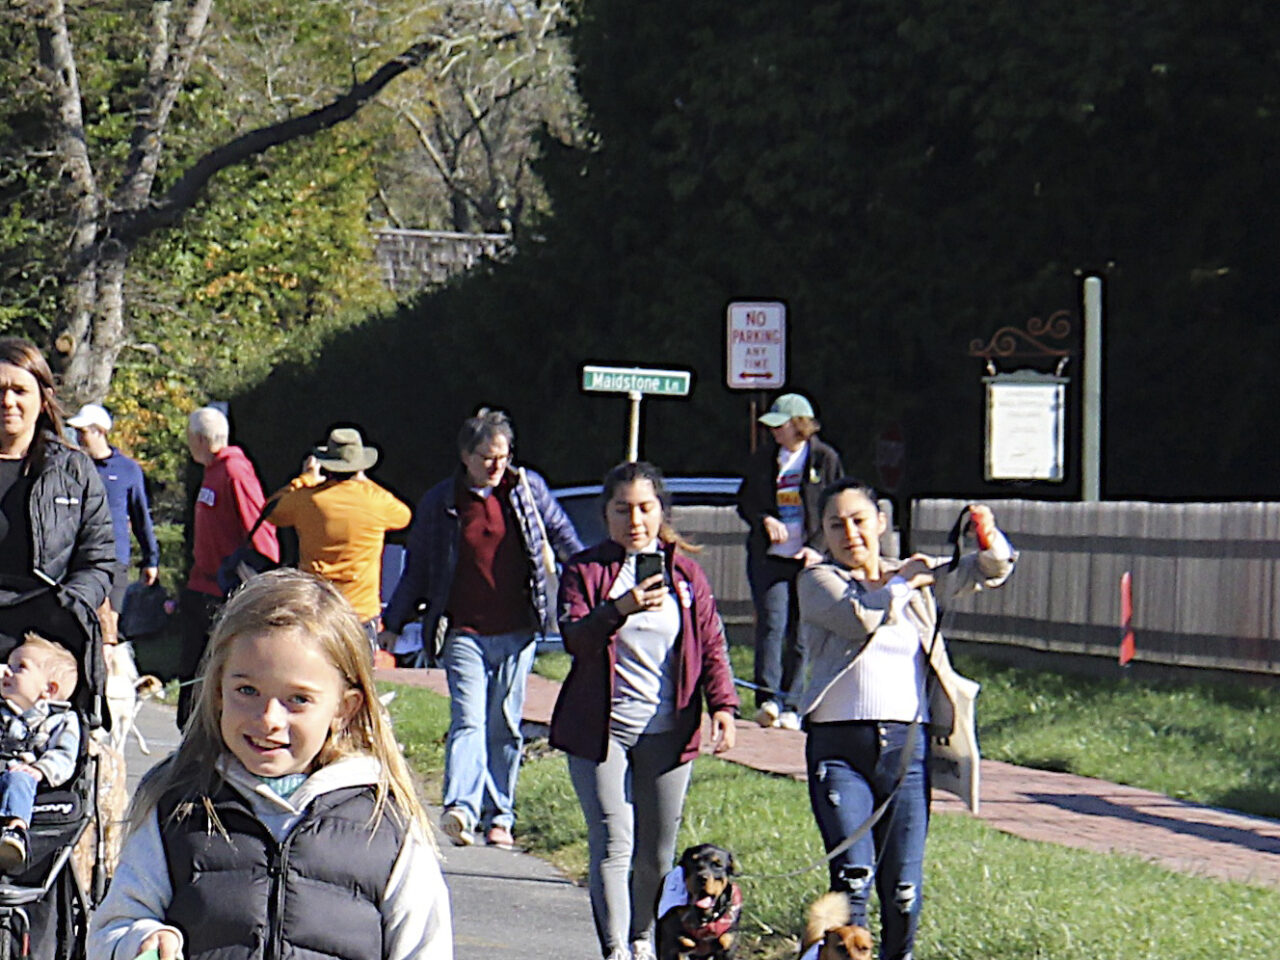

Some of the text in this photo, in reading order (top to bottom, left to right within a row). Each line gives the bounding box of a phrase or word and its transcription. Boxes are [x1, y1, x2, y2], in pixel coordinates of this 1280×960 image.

[746, 311, 767, 327] NO
[733, 329, 781, 344] PARKING
[746, 347, 767, 356] ANY
[745, 359, 768, 369] TIME
[592, 372, 680, 391] Maidstone Ln
[31, 803, 73, 814] oovy
